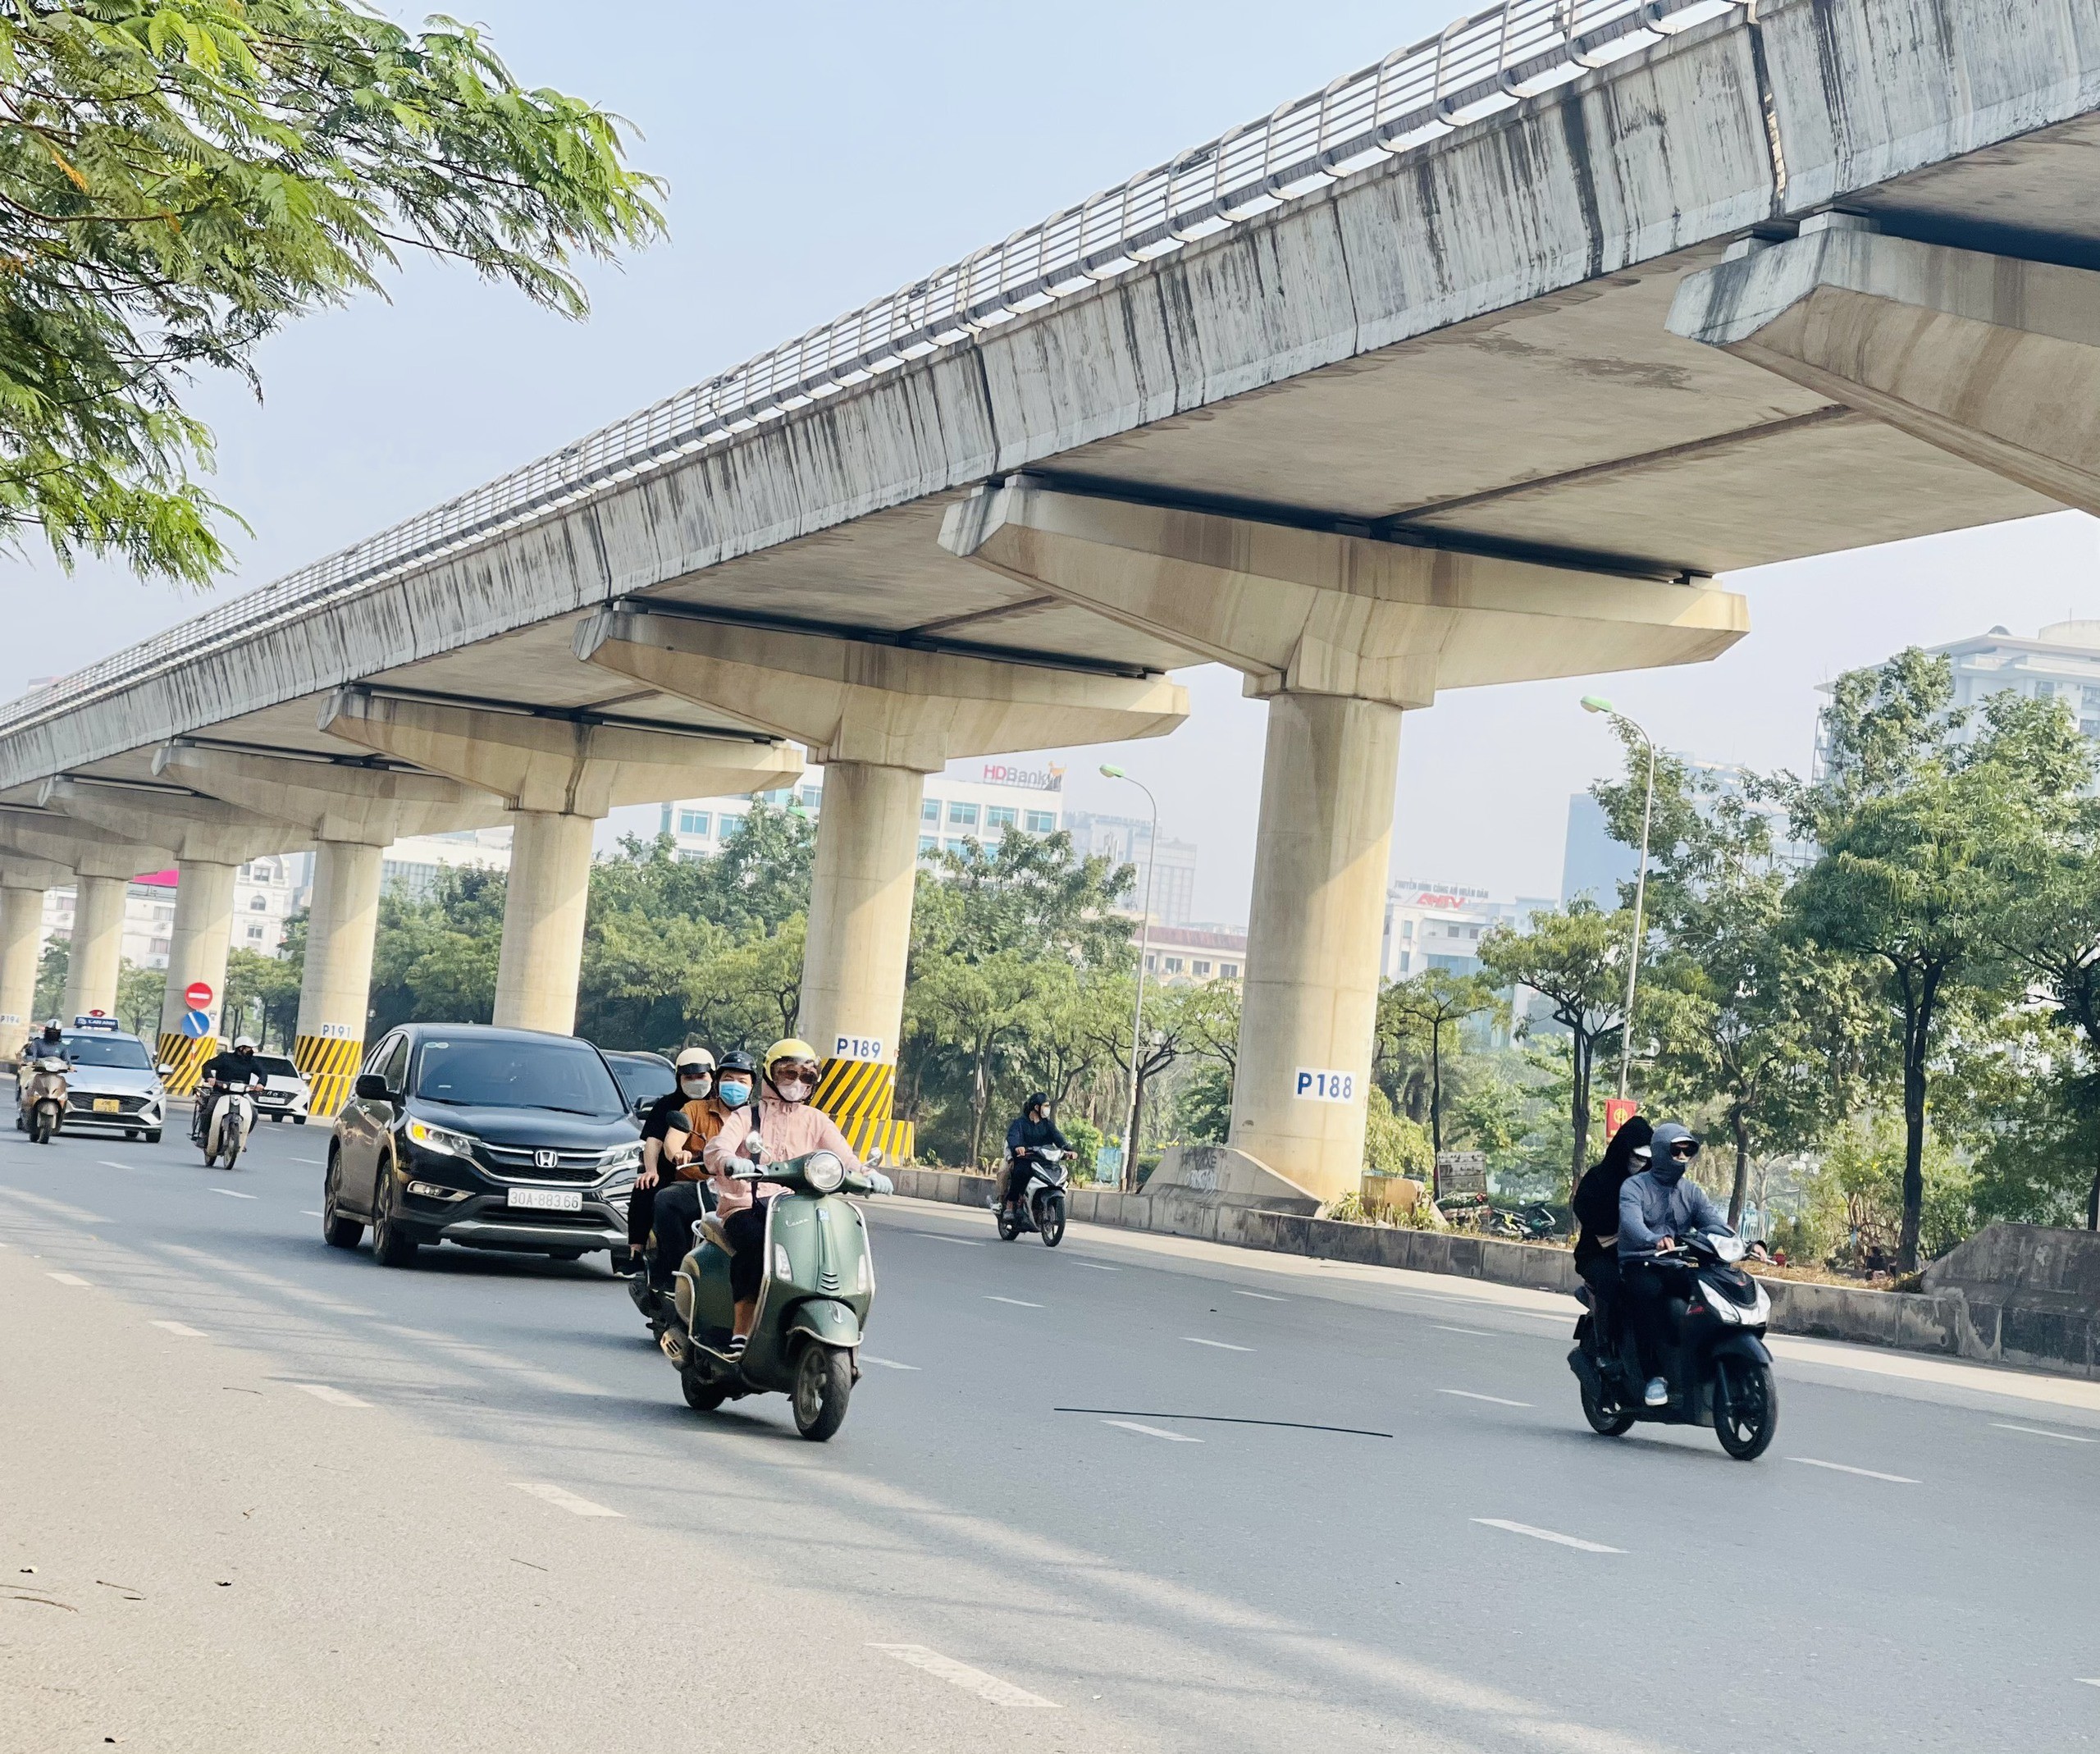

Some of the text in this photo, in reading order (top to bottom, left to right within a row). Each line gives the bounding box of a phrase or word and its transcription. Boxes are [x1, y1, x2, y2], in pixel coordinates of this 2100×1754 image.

[984, 764, 1048, 785] HDBank
[322, 1025, 350, 1038] P191
[837, 1038, 880, 1058] P189
[1298, 1072, 1352, 1099] P188
